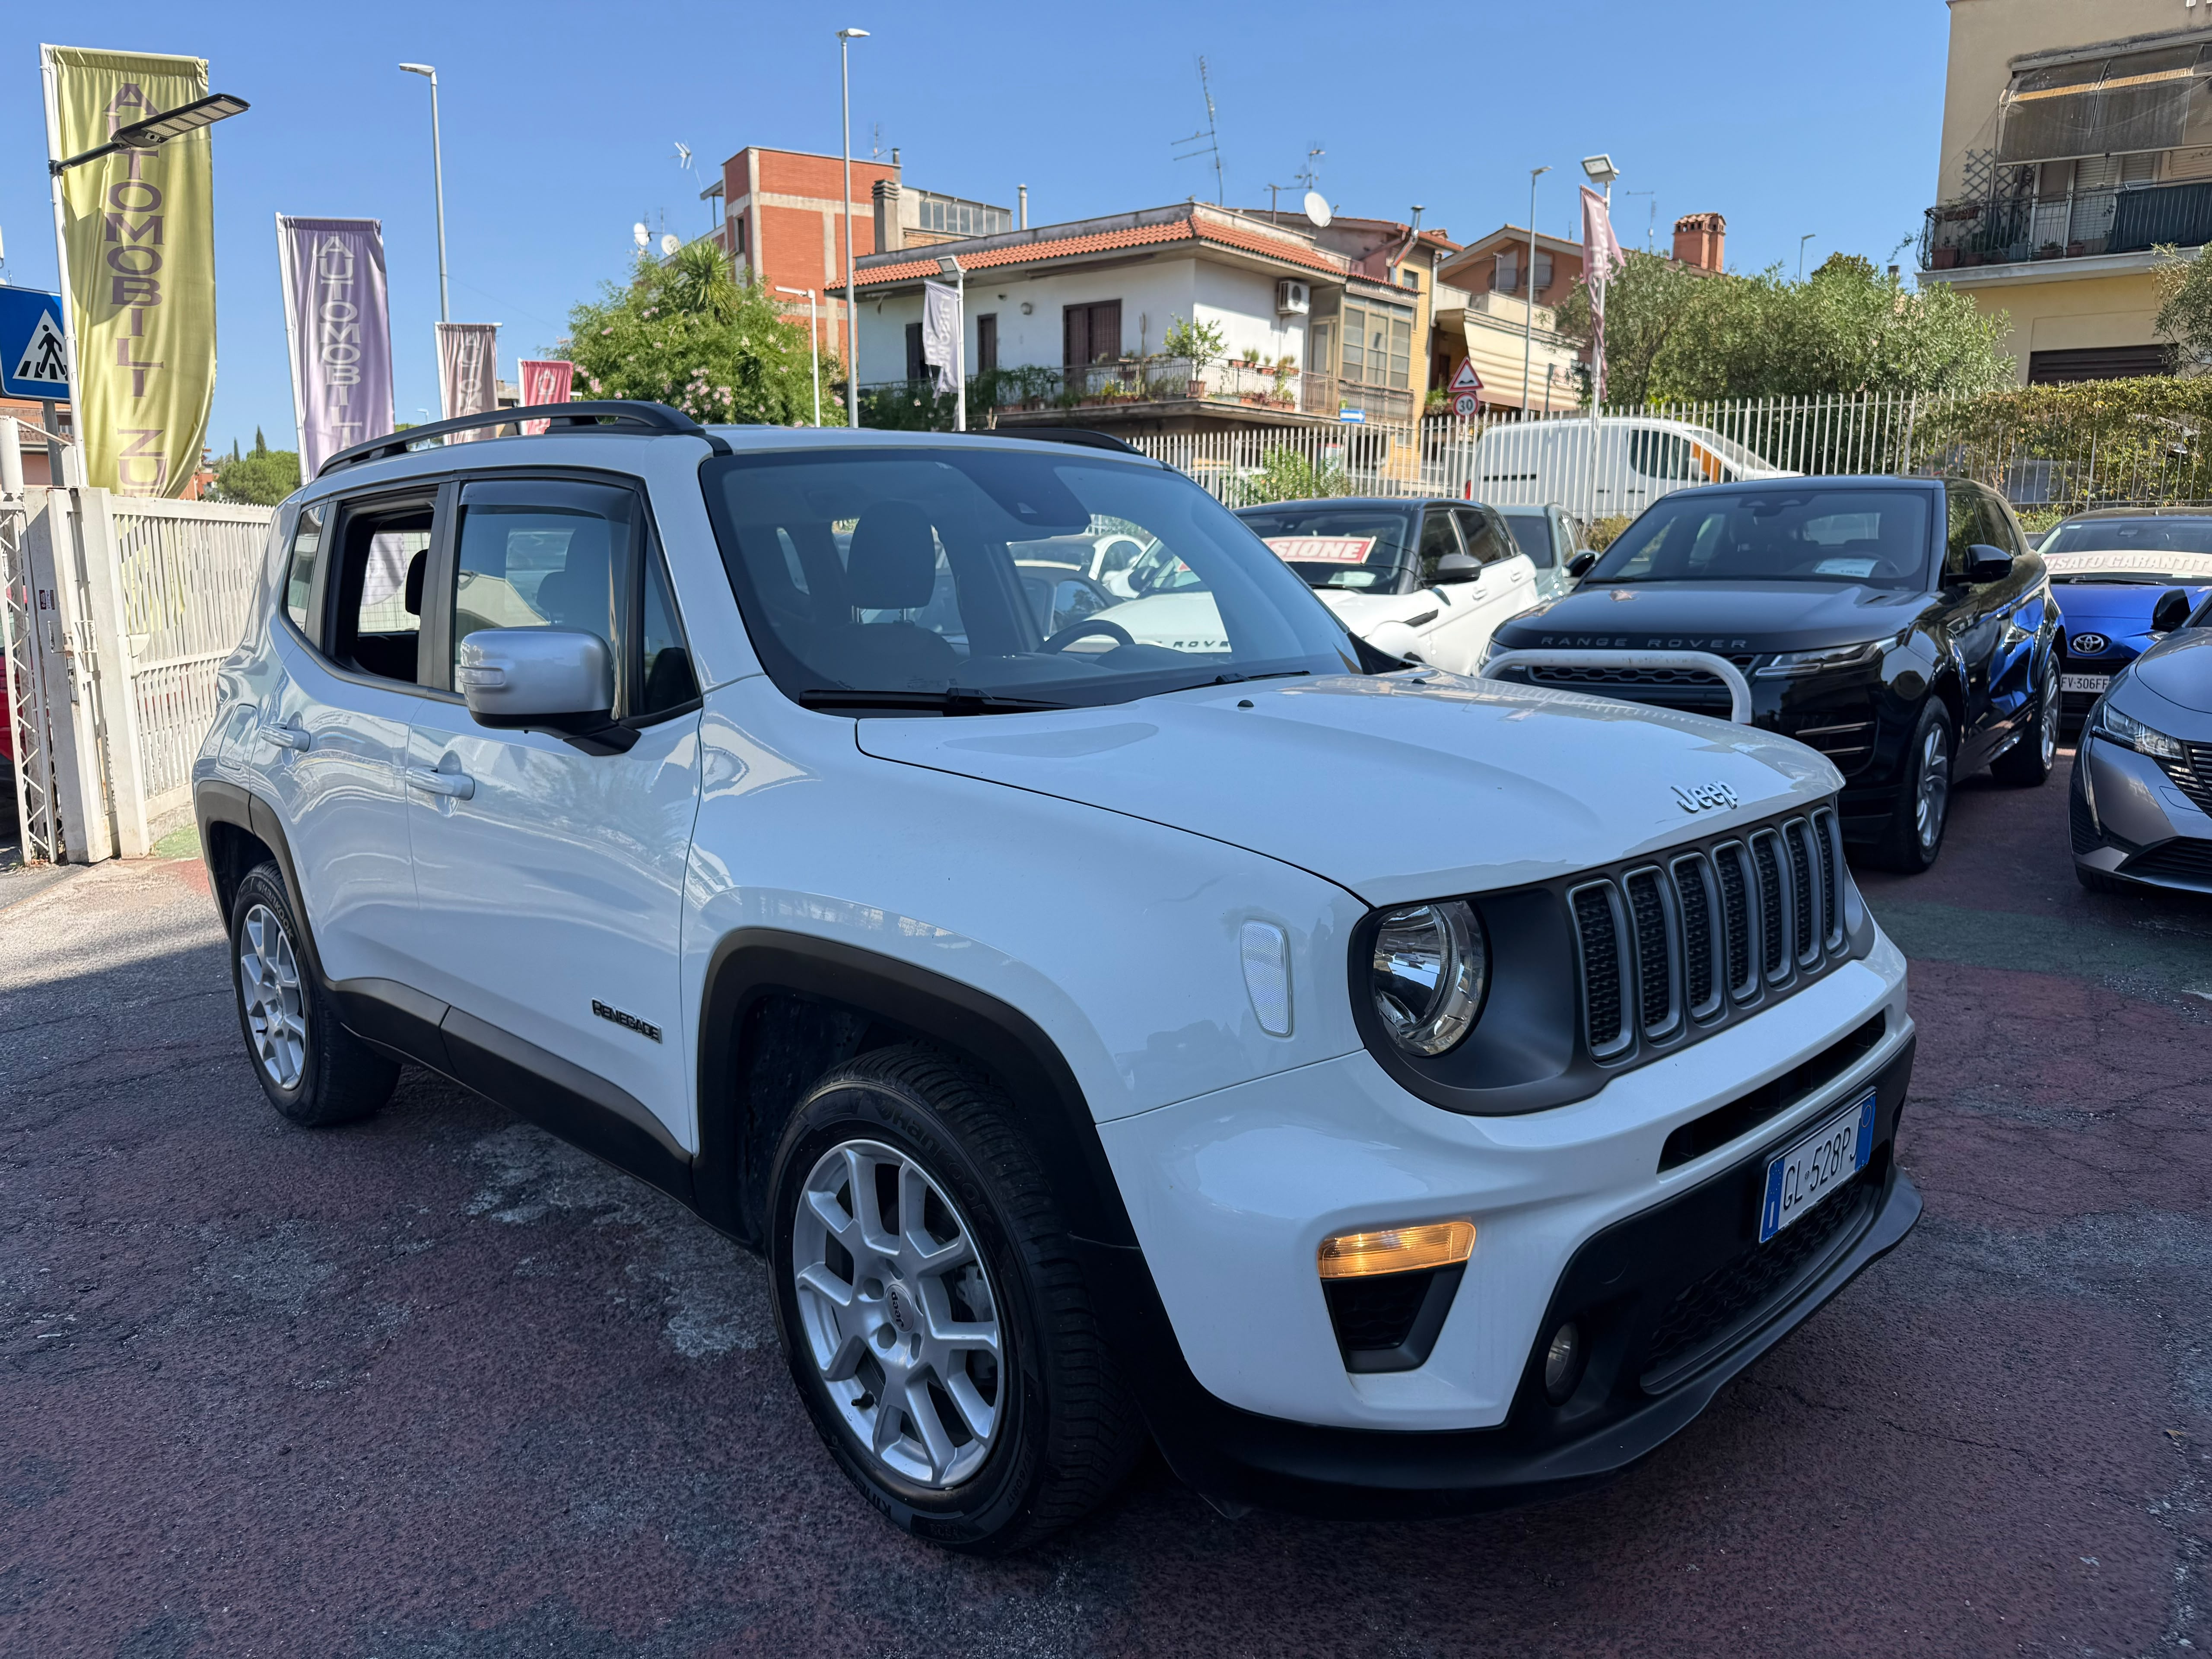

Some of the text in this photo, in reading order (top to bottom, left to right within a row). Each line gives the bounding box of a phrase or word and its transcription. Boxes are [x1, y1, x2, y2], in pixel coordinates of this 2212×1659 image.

[317, 236, 362, 448] AUTOMOBILI
[1458, 398, 1474, 412] 30
[117, 428, 168, 497] ZU
[1541, 636, 1748, 648] RANGE ROVER
[1670, 781, 1738, 814] Jeep
[591, 997, 663, 1044] RENEGADE
[891, 1291, 904, 1328] Jeep
